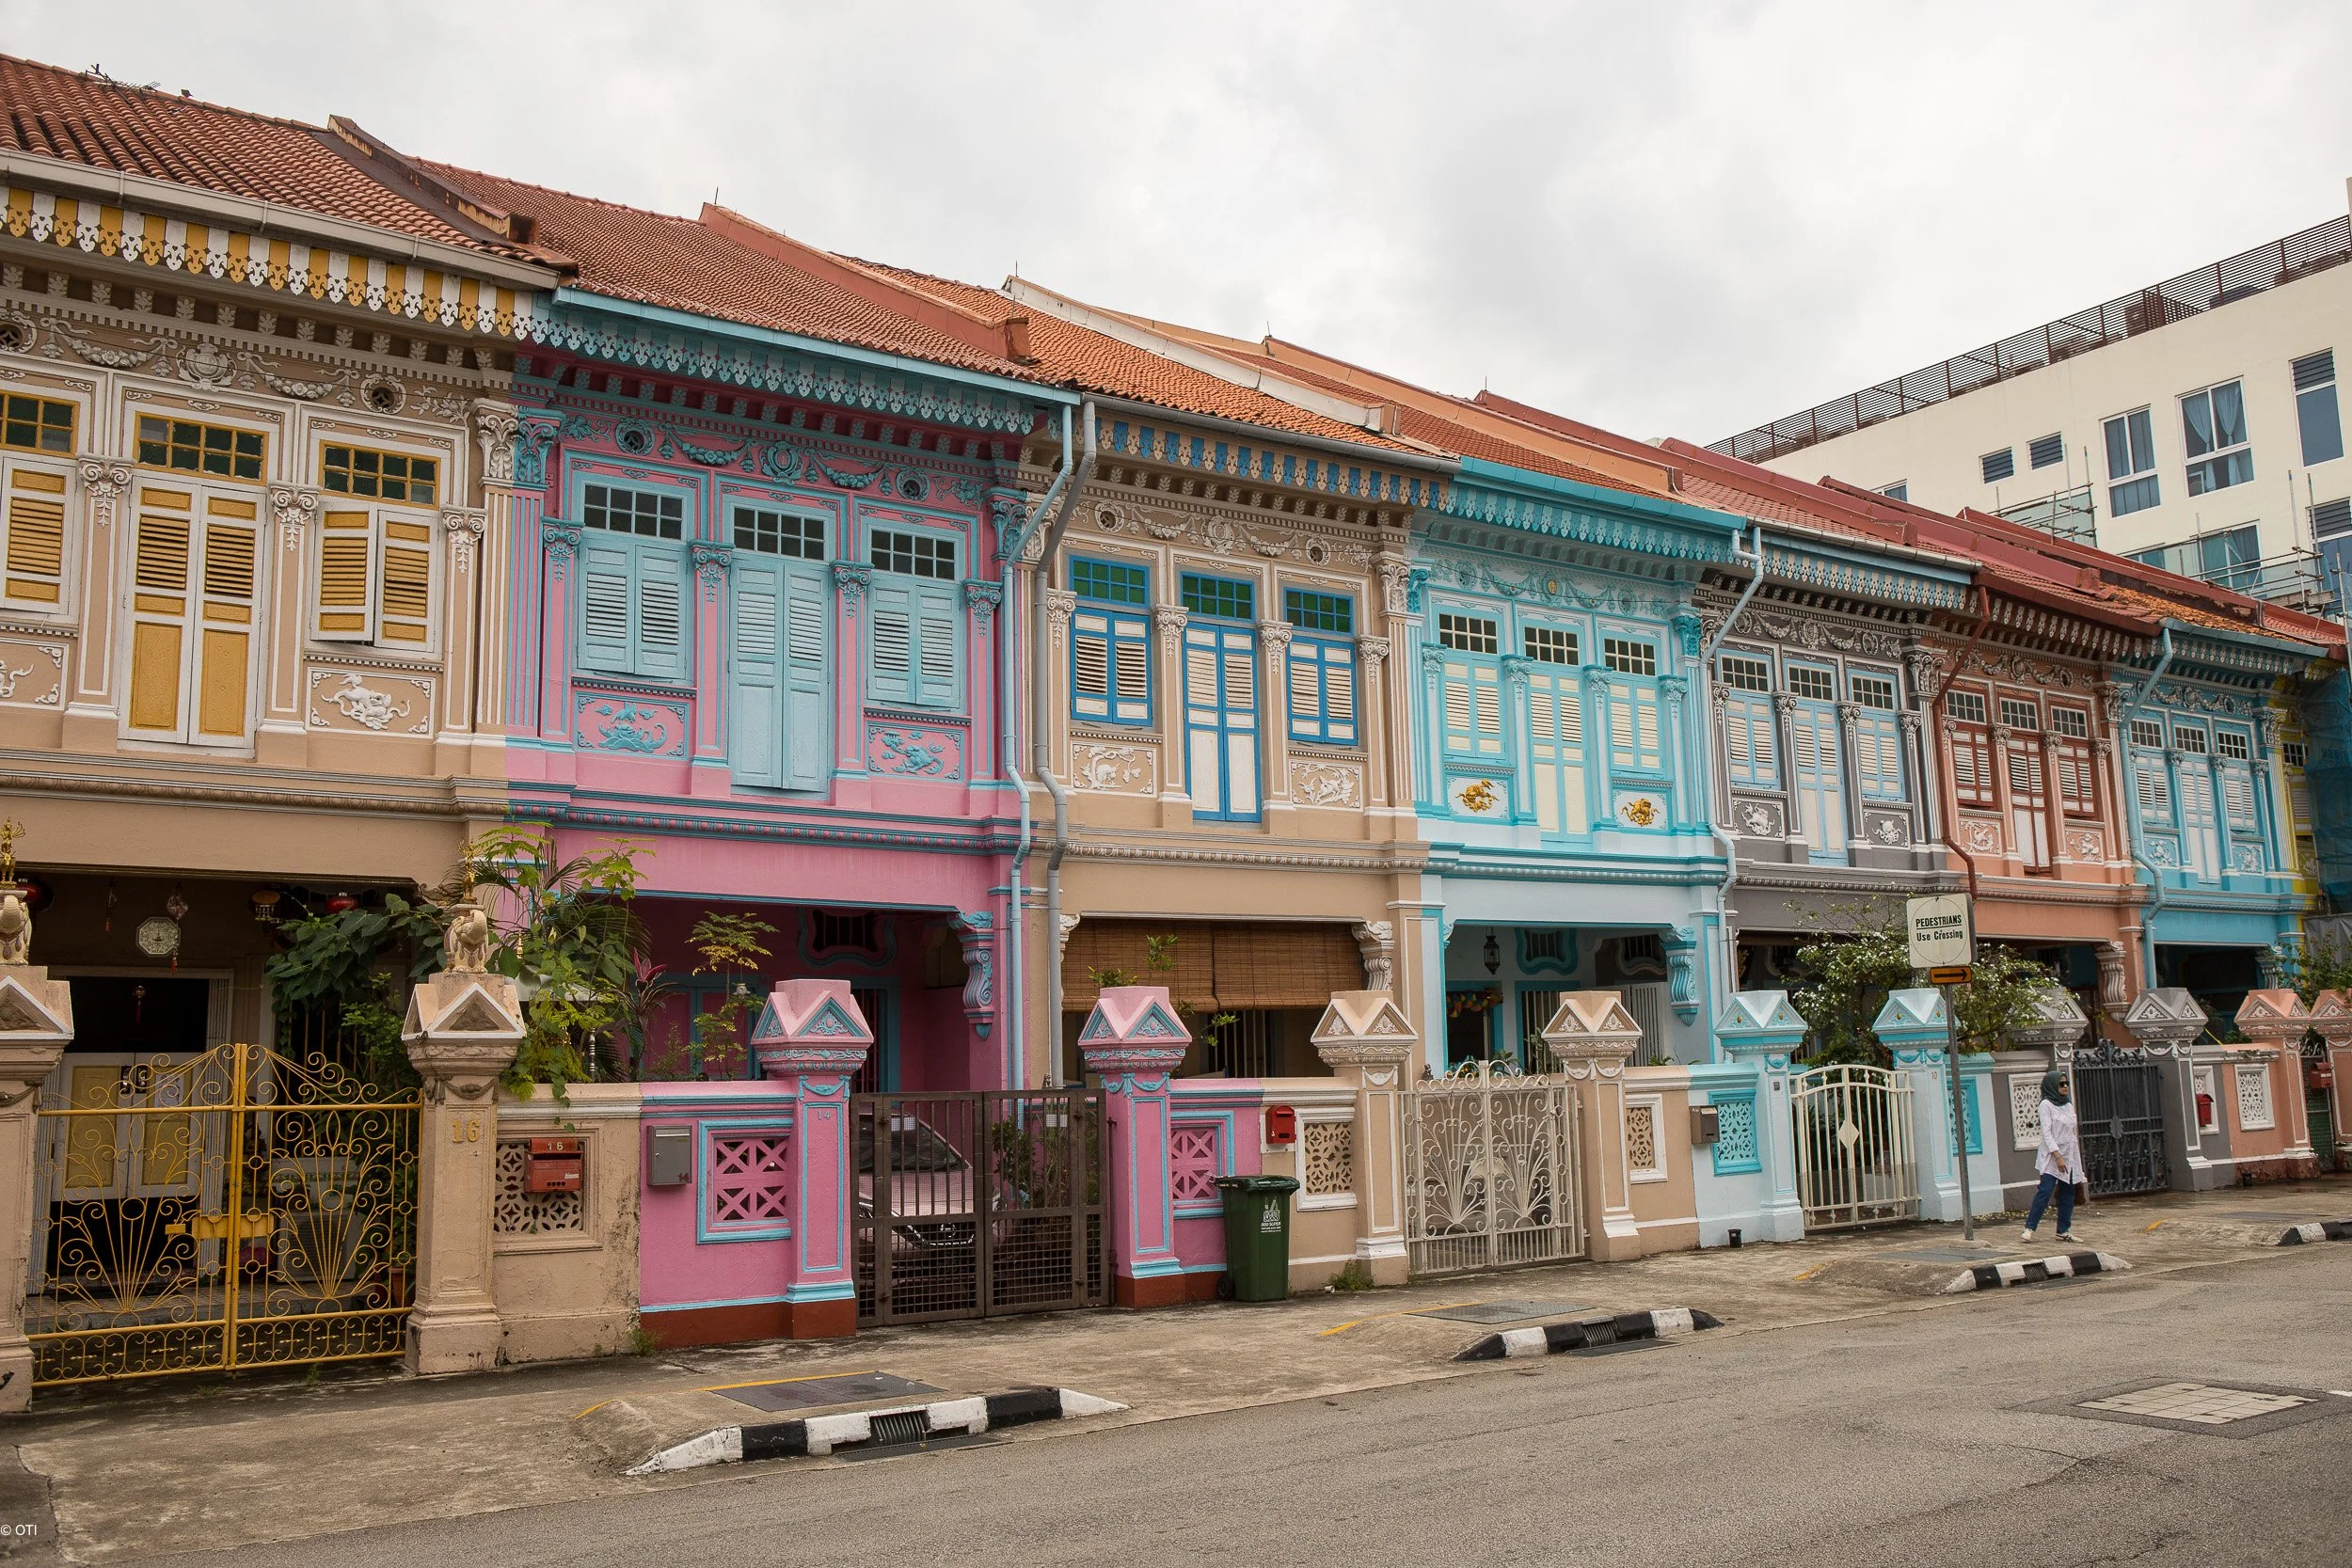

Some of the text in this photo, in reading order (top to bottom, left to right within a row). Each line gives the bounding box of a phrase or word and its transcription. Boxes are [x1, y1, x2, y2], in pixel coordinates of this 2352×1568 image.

[1915, 914, 1962, 927] PEDESTRIANS
[1916, 929, 1963, 942] Use Crossing
[1931, 1070, 1938, 1080] 10
[817, 1110, 831, 1119] 14
[452, 1119, 481, 1144] 16
[548, 1141, 564, 1151] 16
